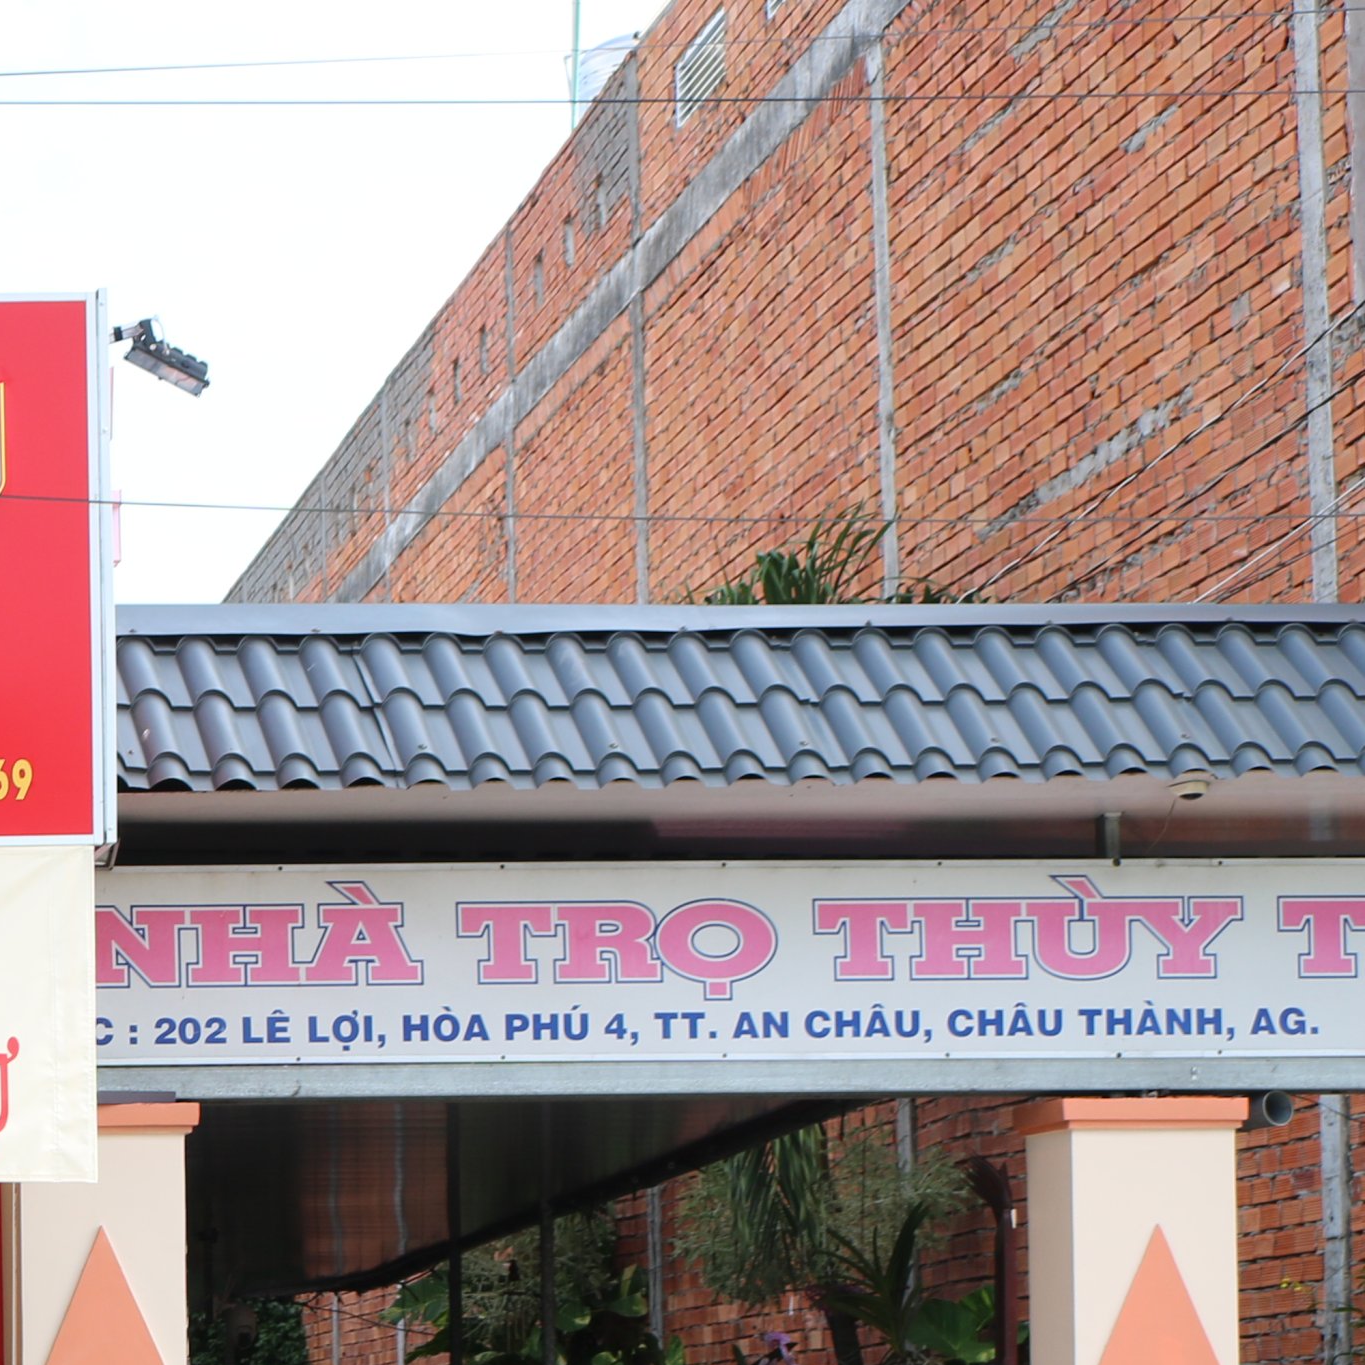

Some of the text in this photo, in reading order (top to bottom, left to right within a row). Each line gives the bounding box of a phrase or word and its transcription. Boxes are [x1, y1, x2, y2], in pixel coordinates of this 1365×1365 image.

[96, 881, 424, 988] NHÀ
[456, 898, 778, 1001] TRỌ
[813, 875, 1244, 981] THÙY
[156, 1017, 226, 1044] 202
[243, 1010, 290, 1043] LÊ
[310, 1010, 385, 1050] LỢI,
[403, 1006, 489, 1041] HÒA
[506, 1005, 588, 1040] PHÚ
[605, 1014, 638, 1045] 4,
[655, 1012, 716, 1039] TT.
[734, 1012, 789, 1038] AN
[806, 1004, 932, 1041] CHÂU,
[949, 1003, 1062, 1037] CHÂU
[1079, 1001, 1234, 1040] THÀNH,
[1253, 1008, 1318, 1035] AG.
